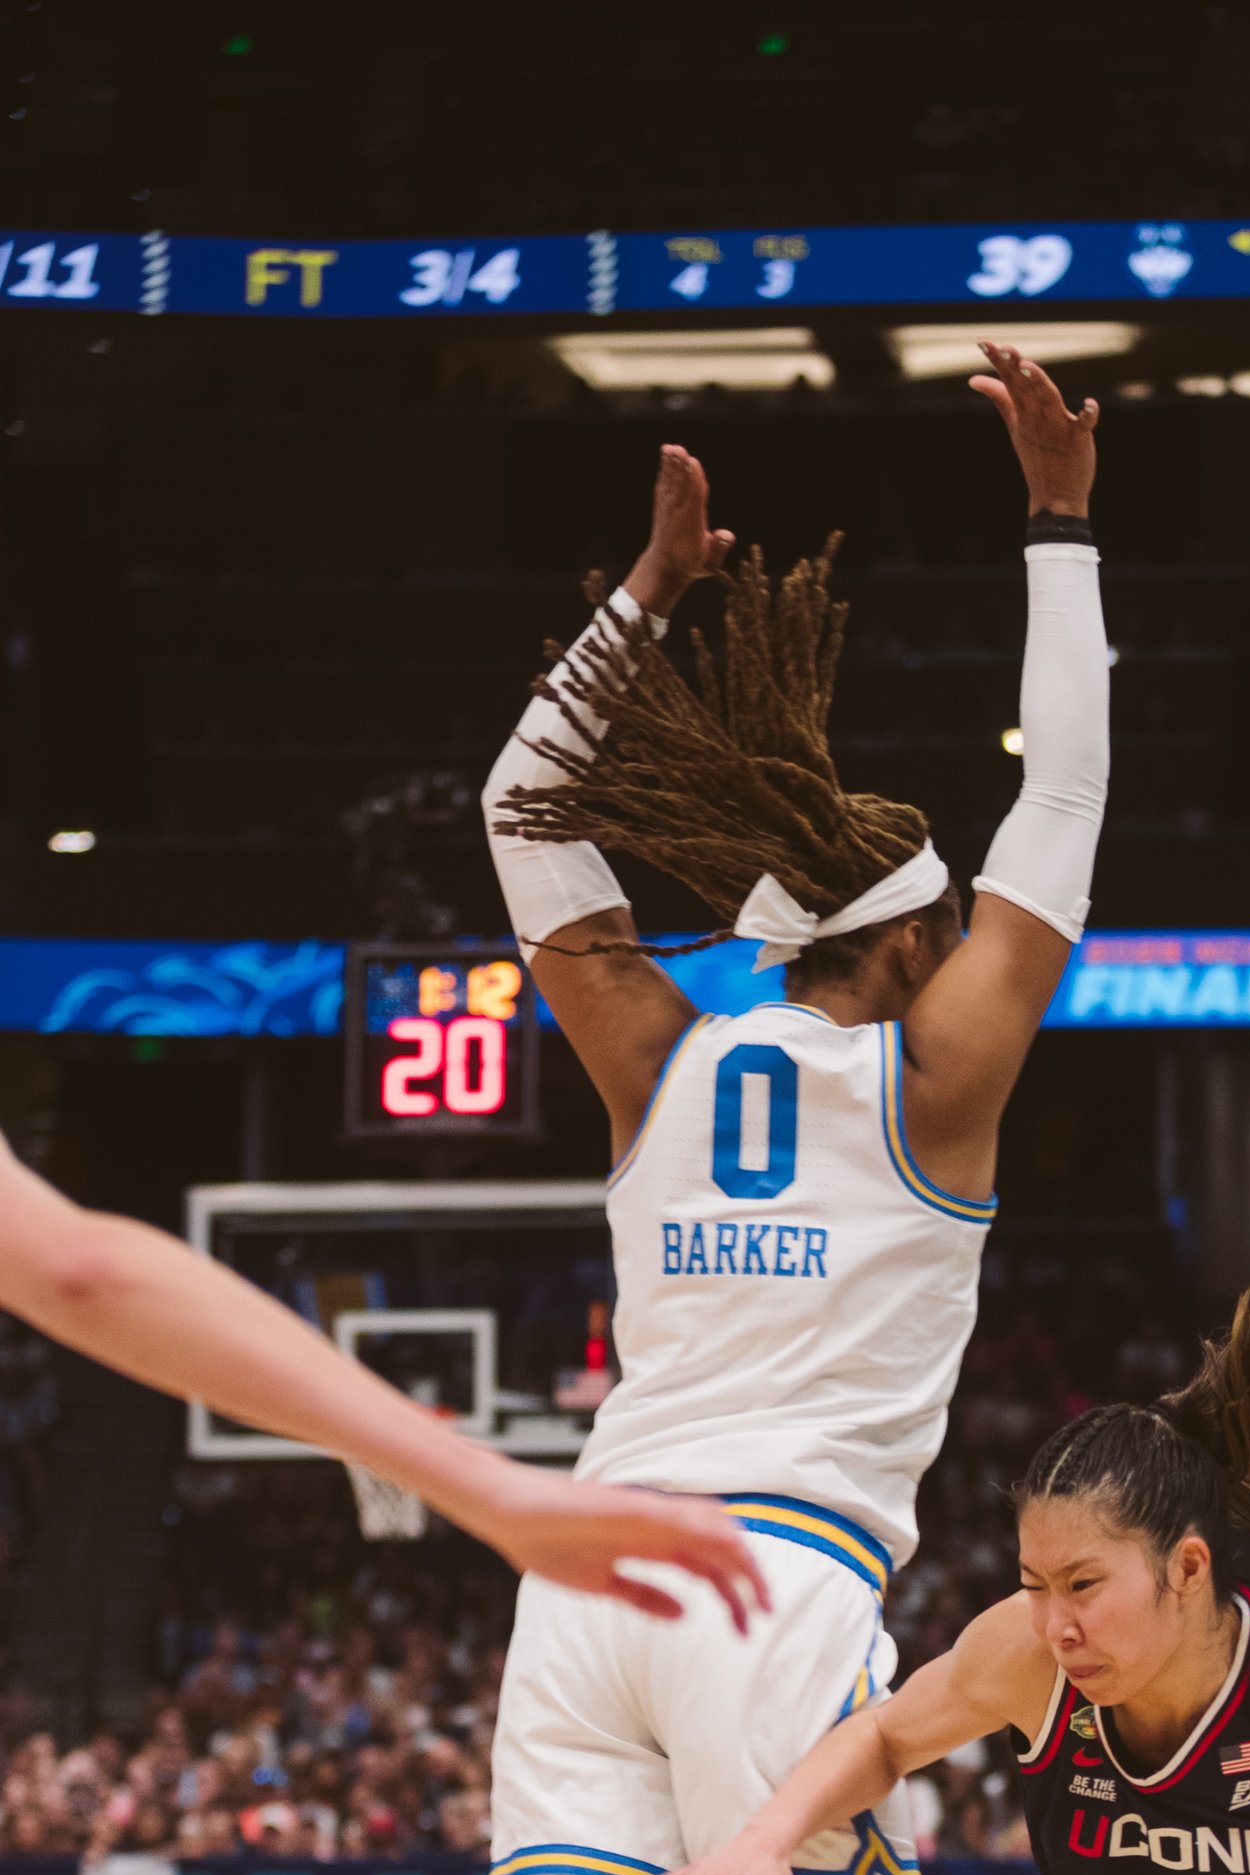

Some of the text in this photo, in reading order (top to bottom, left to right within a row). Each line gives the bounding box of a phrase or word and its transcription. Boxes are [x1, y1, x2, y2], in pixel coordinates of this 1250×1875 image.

[245, 248, 339, 307] FT
[399, 248, 521, 306] 3/4
[669, 262, 709, 300] 4
[755, 259, 796, 298] 3
[966, 234, 1073, 297] 39
[381, 1015, 507, 1117] 20
[712, 1043, 799, 1200] 0
[661, 1222, 829, 1279] BARKER
[1069, 1784, 1118, 1802] CHANGE
[1073, 1774, 1116, 1792] BE THE
